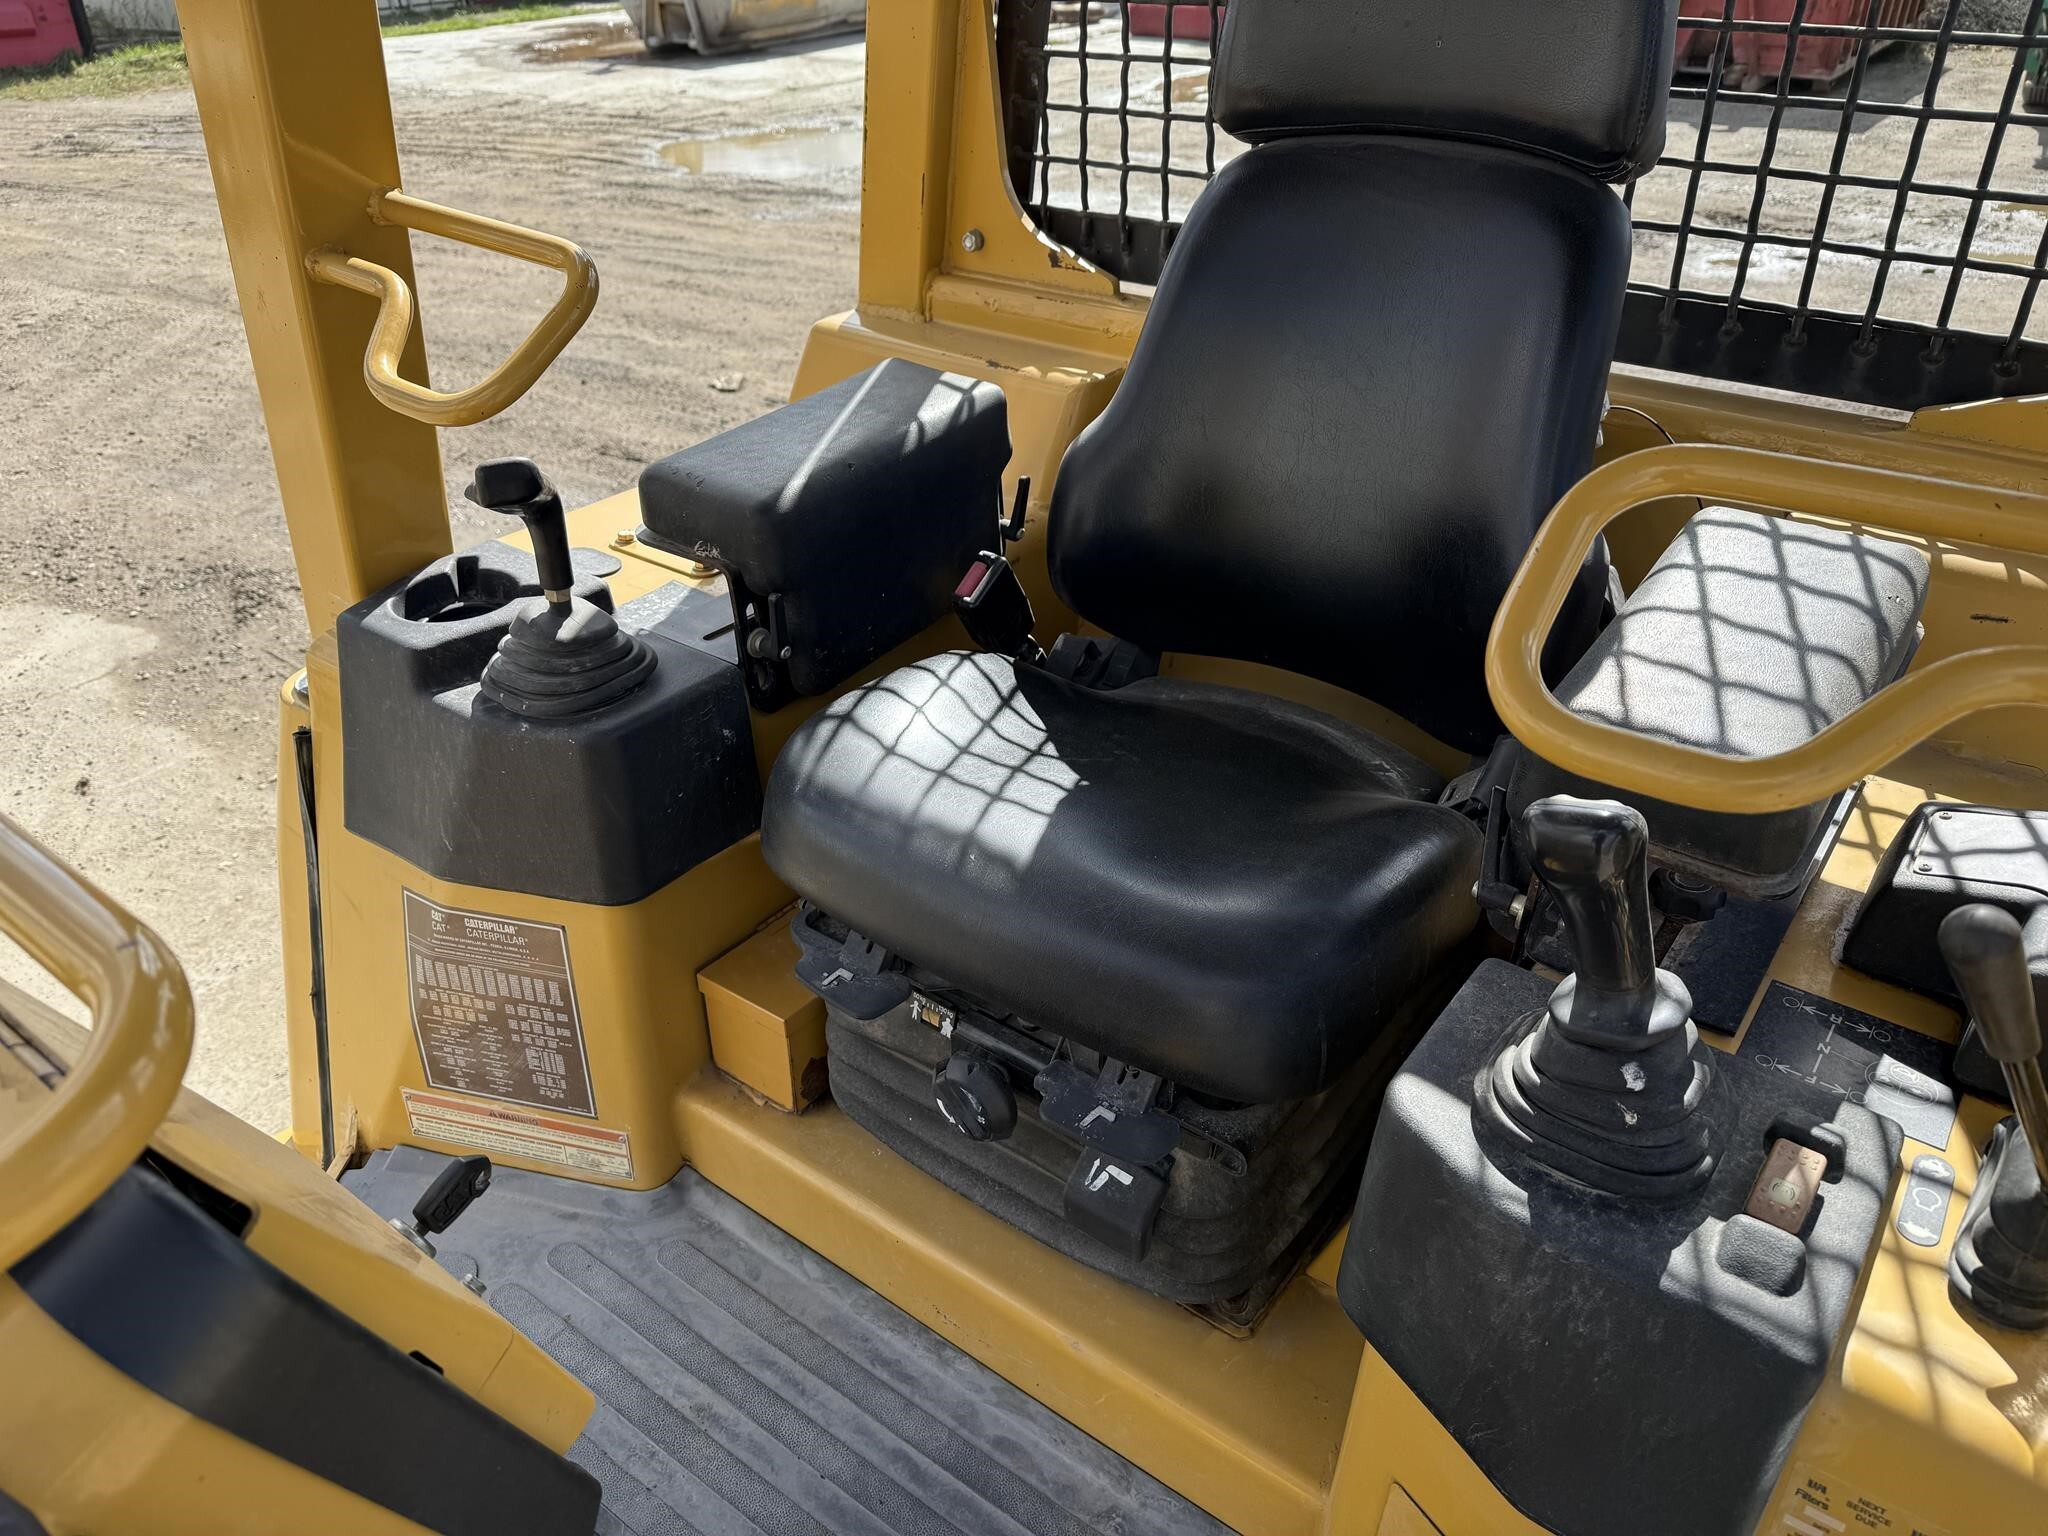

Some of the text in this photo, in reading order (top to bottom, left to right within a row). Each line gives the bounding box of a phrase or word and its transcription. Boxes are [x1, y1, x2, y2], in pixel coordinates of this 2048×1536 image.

[1830, 1013, 1843, 1025] R
[1817, 1042, 1831, 1054] N
[1804, 1075, 1817, 1085] F
[496, 1111, 540, 1127] WARNING
[1794, 1487, 1829, 1511] Filters
[1857, 1497, 1888, 1516] NEXT
[1846, 1499, 1893, 1528] SERVICE
[1855, 1513, 1878, 1530] DUE
